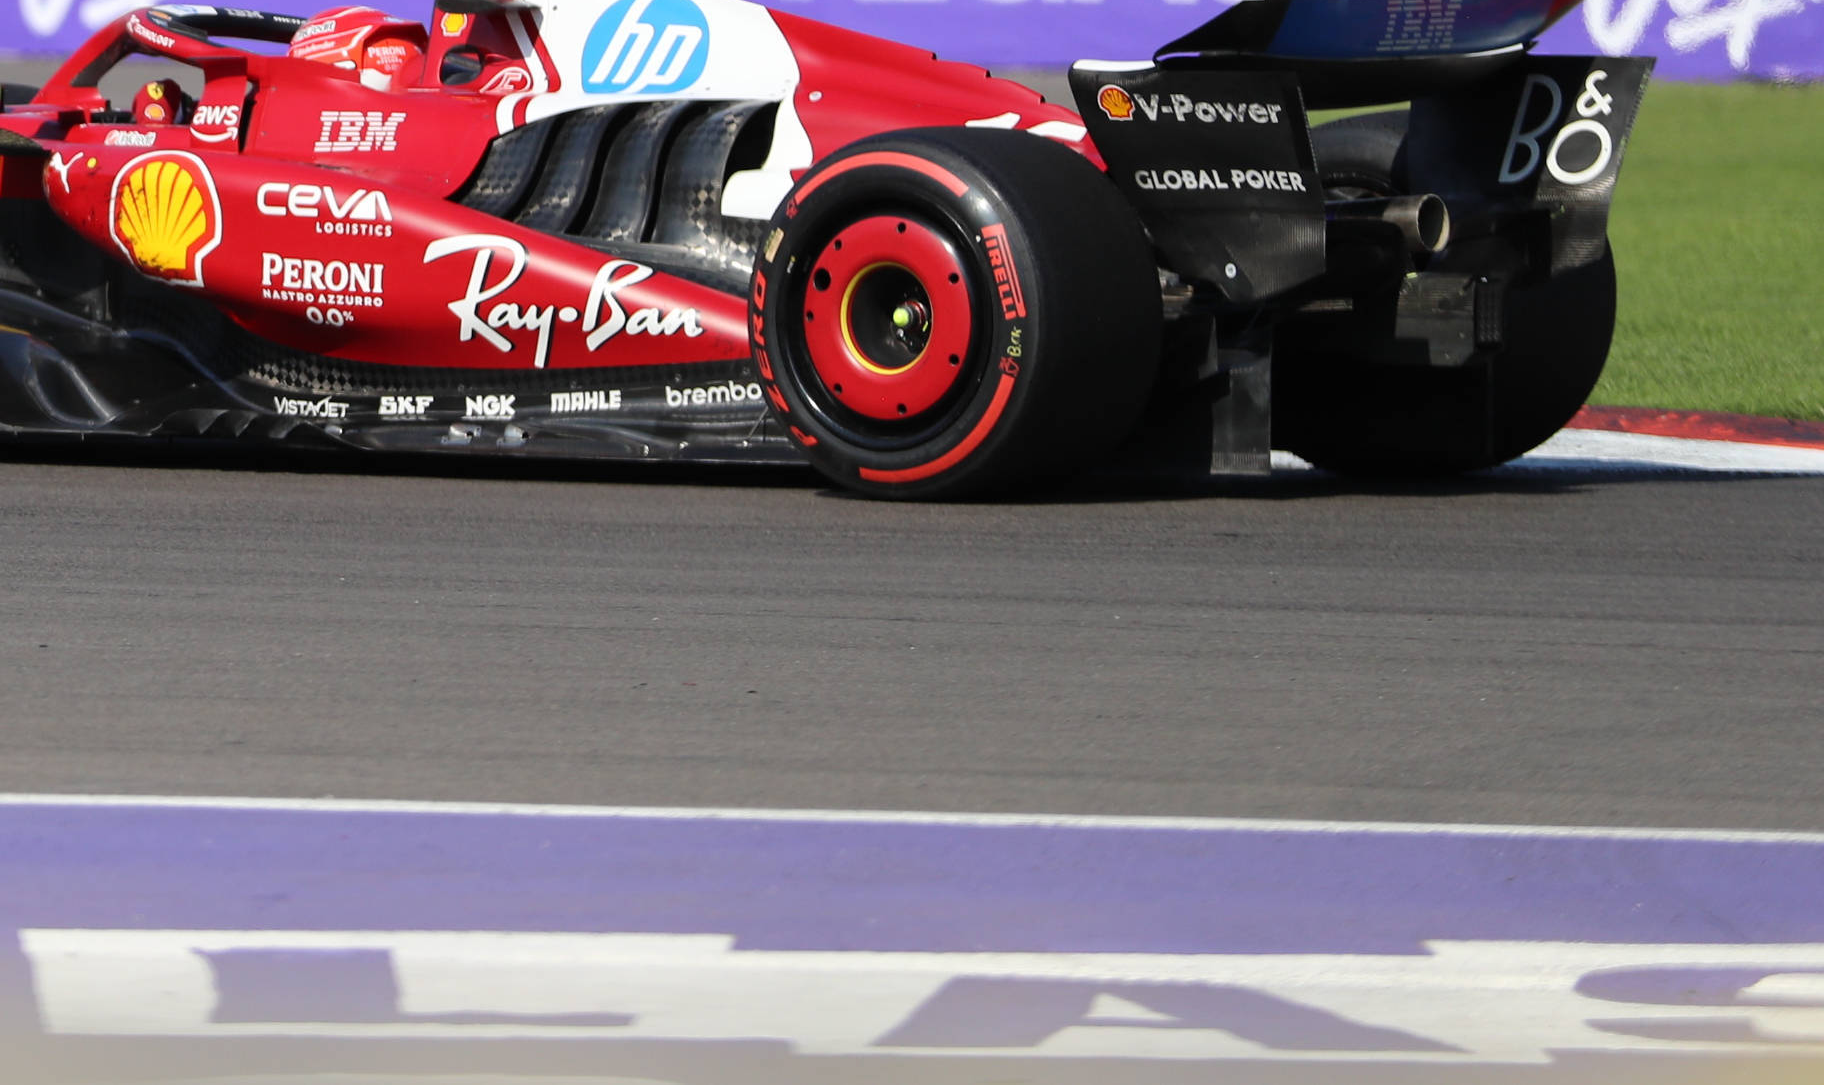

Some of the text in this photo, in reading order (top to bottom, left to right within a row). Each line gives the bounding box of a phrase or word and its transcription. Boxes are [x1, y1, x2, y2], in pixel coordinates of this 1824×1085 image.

[192, 105, 241, 127] aws
[1134, 93, 1283, 124] V-Power
[314, 111, 407, 152] IBM
[1135, 169, 1307, 193] GLOBAL POKER
[315, 221, 393, 238] LOGISTICS
[261, 251, 384, 294] PERONI
[981, 223, 1027, 321] PIRELLI
[262, 288, 384, 308] NASTRO AZZURRO
[749, 268, 791, 414] ZERO
[378, 395, 434, 415] SKF
[465, 394, 516, 416] NGK
[550, 389, 622, 413] MAHLE
[664, 380, 763, 408] brembo
